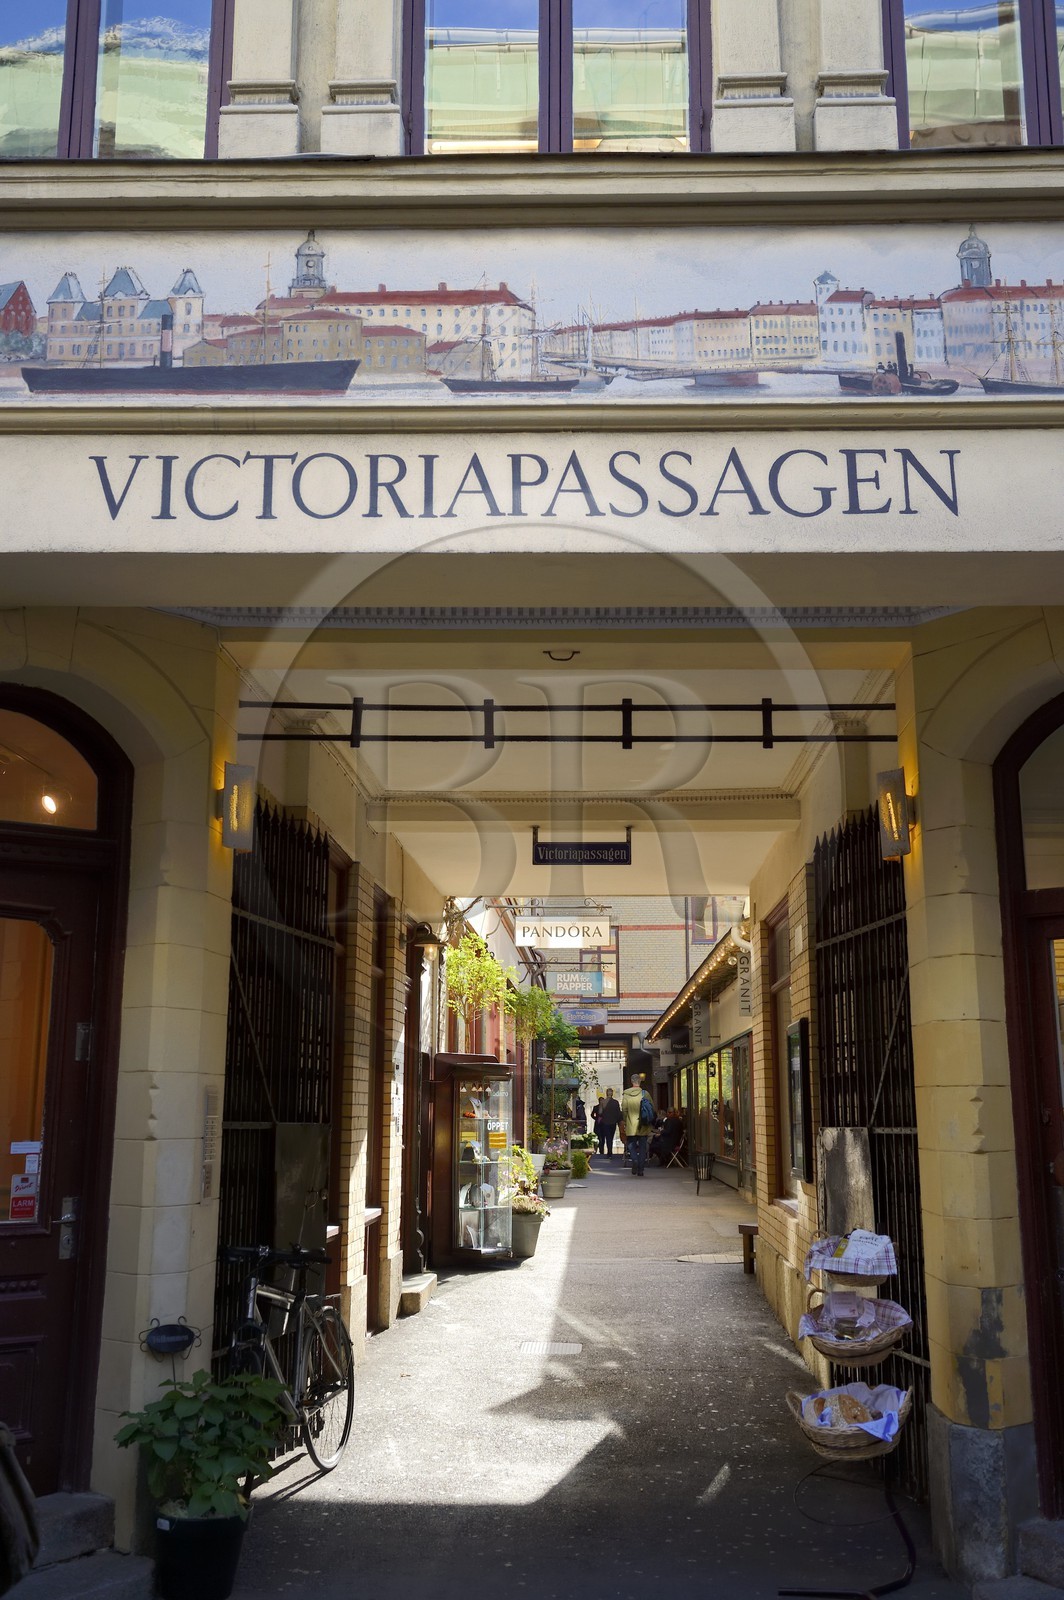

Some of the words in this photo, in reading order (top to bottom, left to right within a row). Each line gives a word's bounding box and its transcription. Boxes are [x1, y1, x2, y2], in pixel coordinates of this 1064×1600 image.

[89, 448, 961, 521] VICTORIAPASSAGEN
[537, 846, 627, 862] Victoriapassagen
[556, 973, 579, 982] RUM
[580, 974, 590, 982] for
[739, 955, 751, 1013] GRANIT
[556, 982, 593, 991] PAPPER
[693, 1003, 703, 1045] GRANIT
[12, 1199, 34, 1208] LARM
